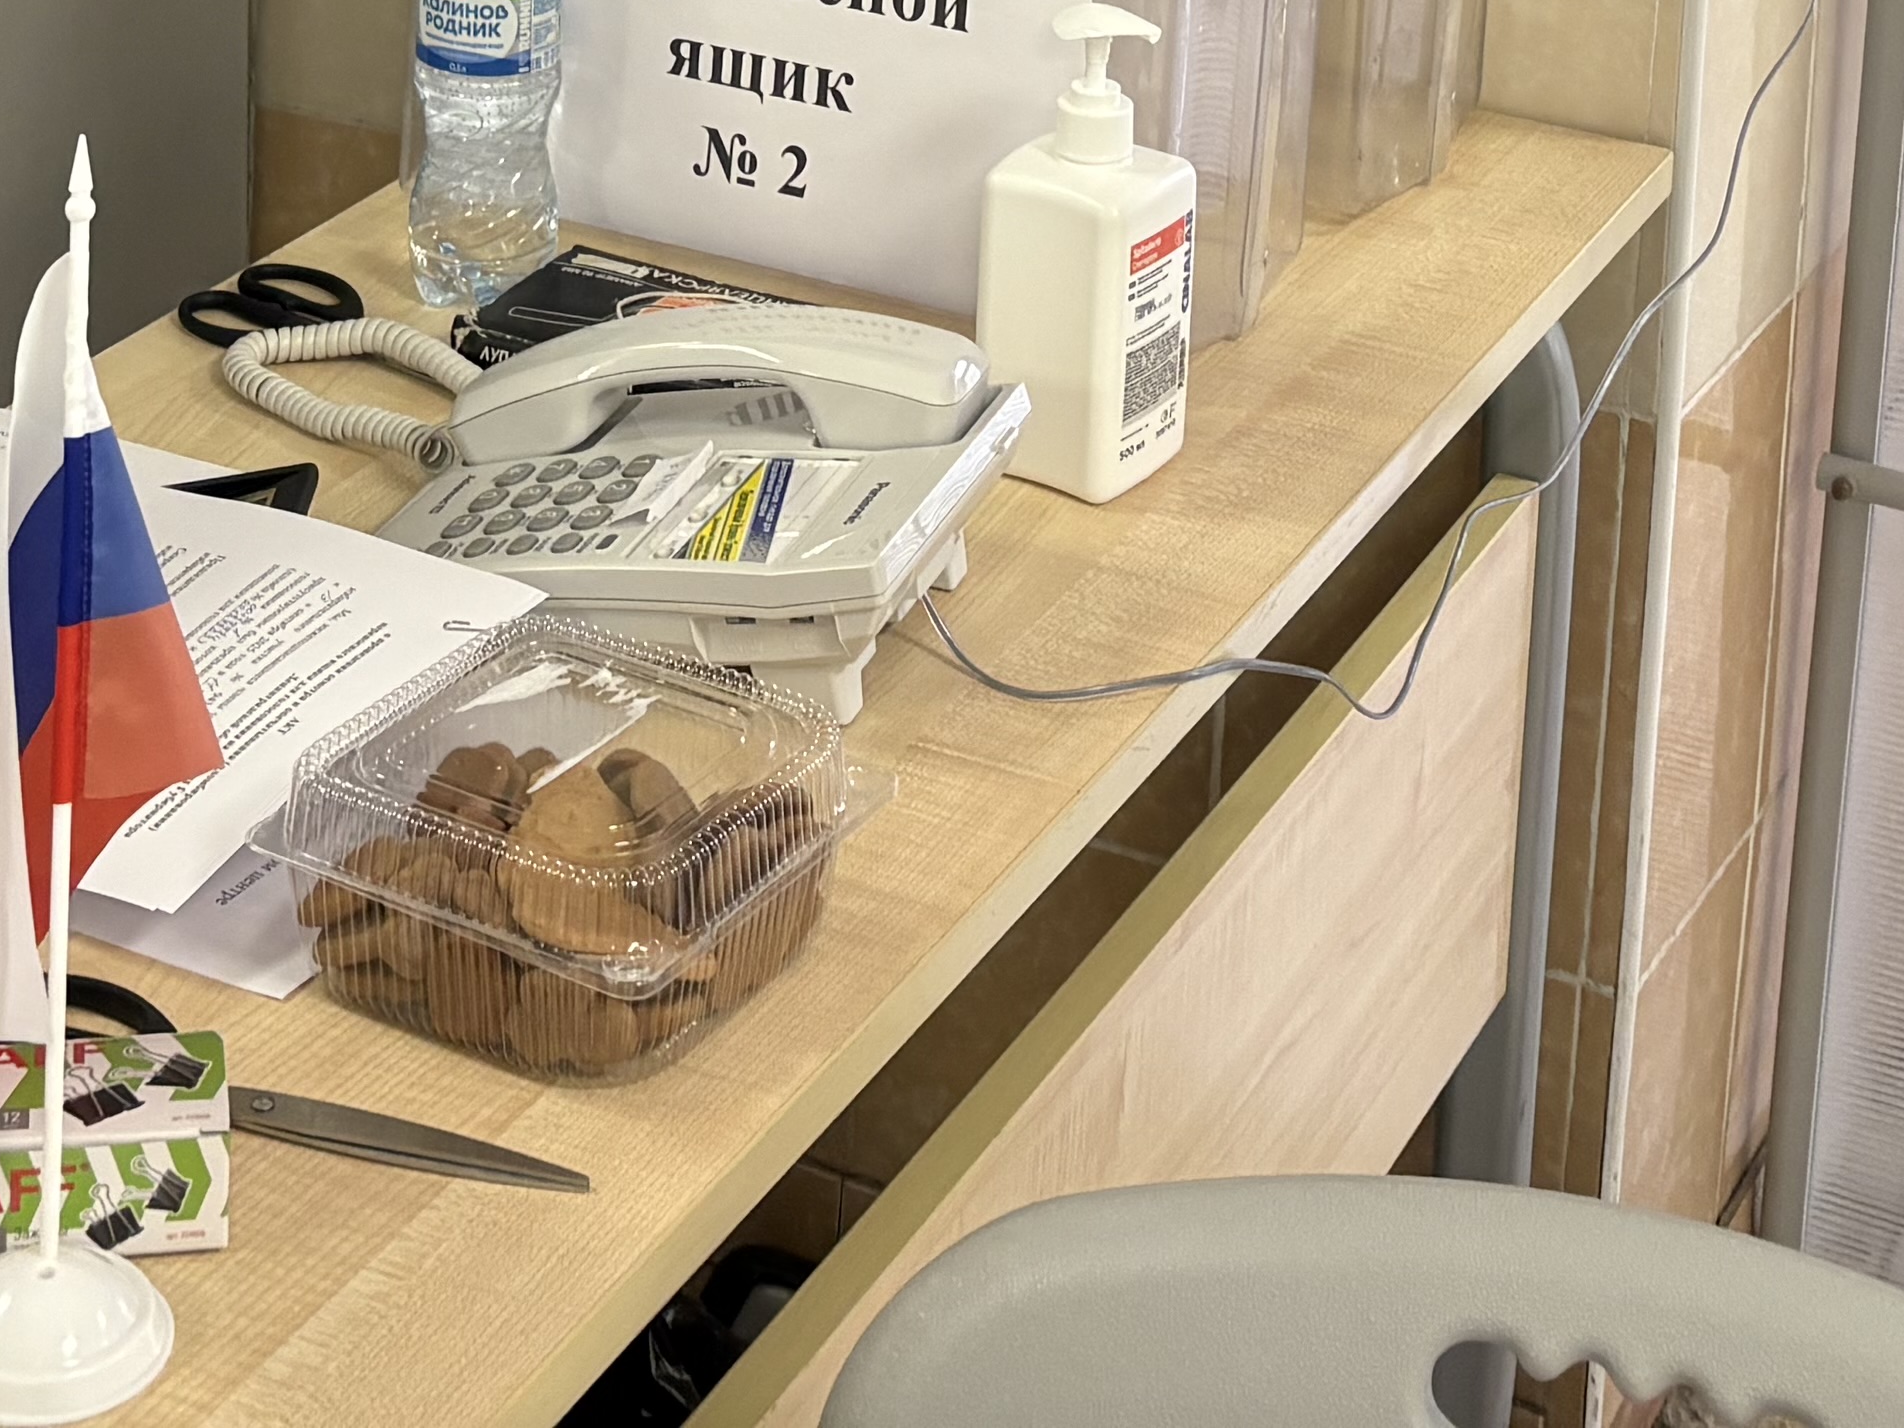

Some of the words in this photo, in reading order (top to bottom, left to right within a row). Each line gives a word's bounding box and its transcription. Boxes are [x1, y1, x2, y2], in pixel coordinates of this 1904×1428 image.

[425, 11, 501, 38] РОДНИК
[666, 40, 854, 115] ящик
[693, 125, 758, 190] №
[778, 145, 809, 199] 2
